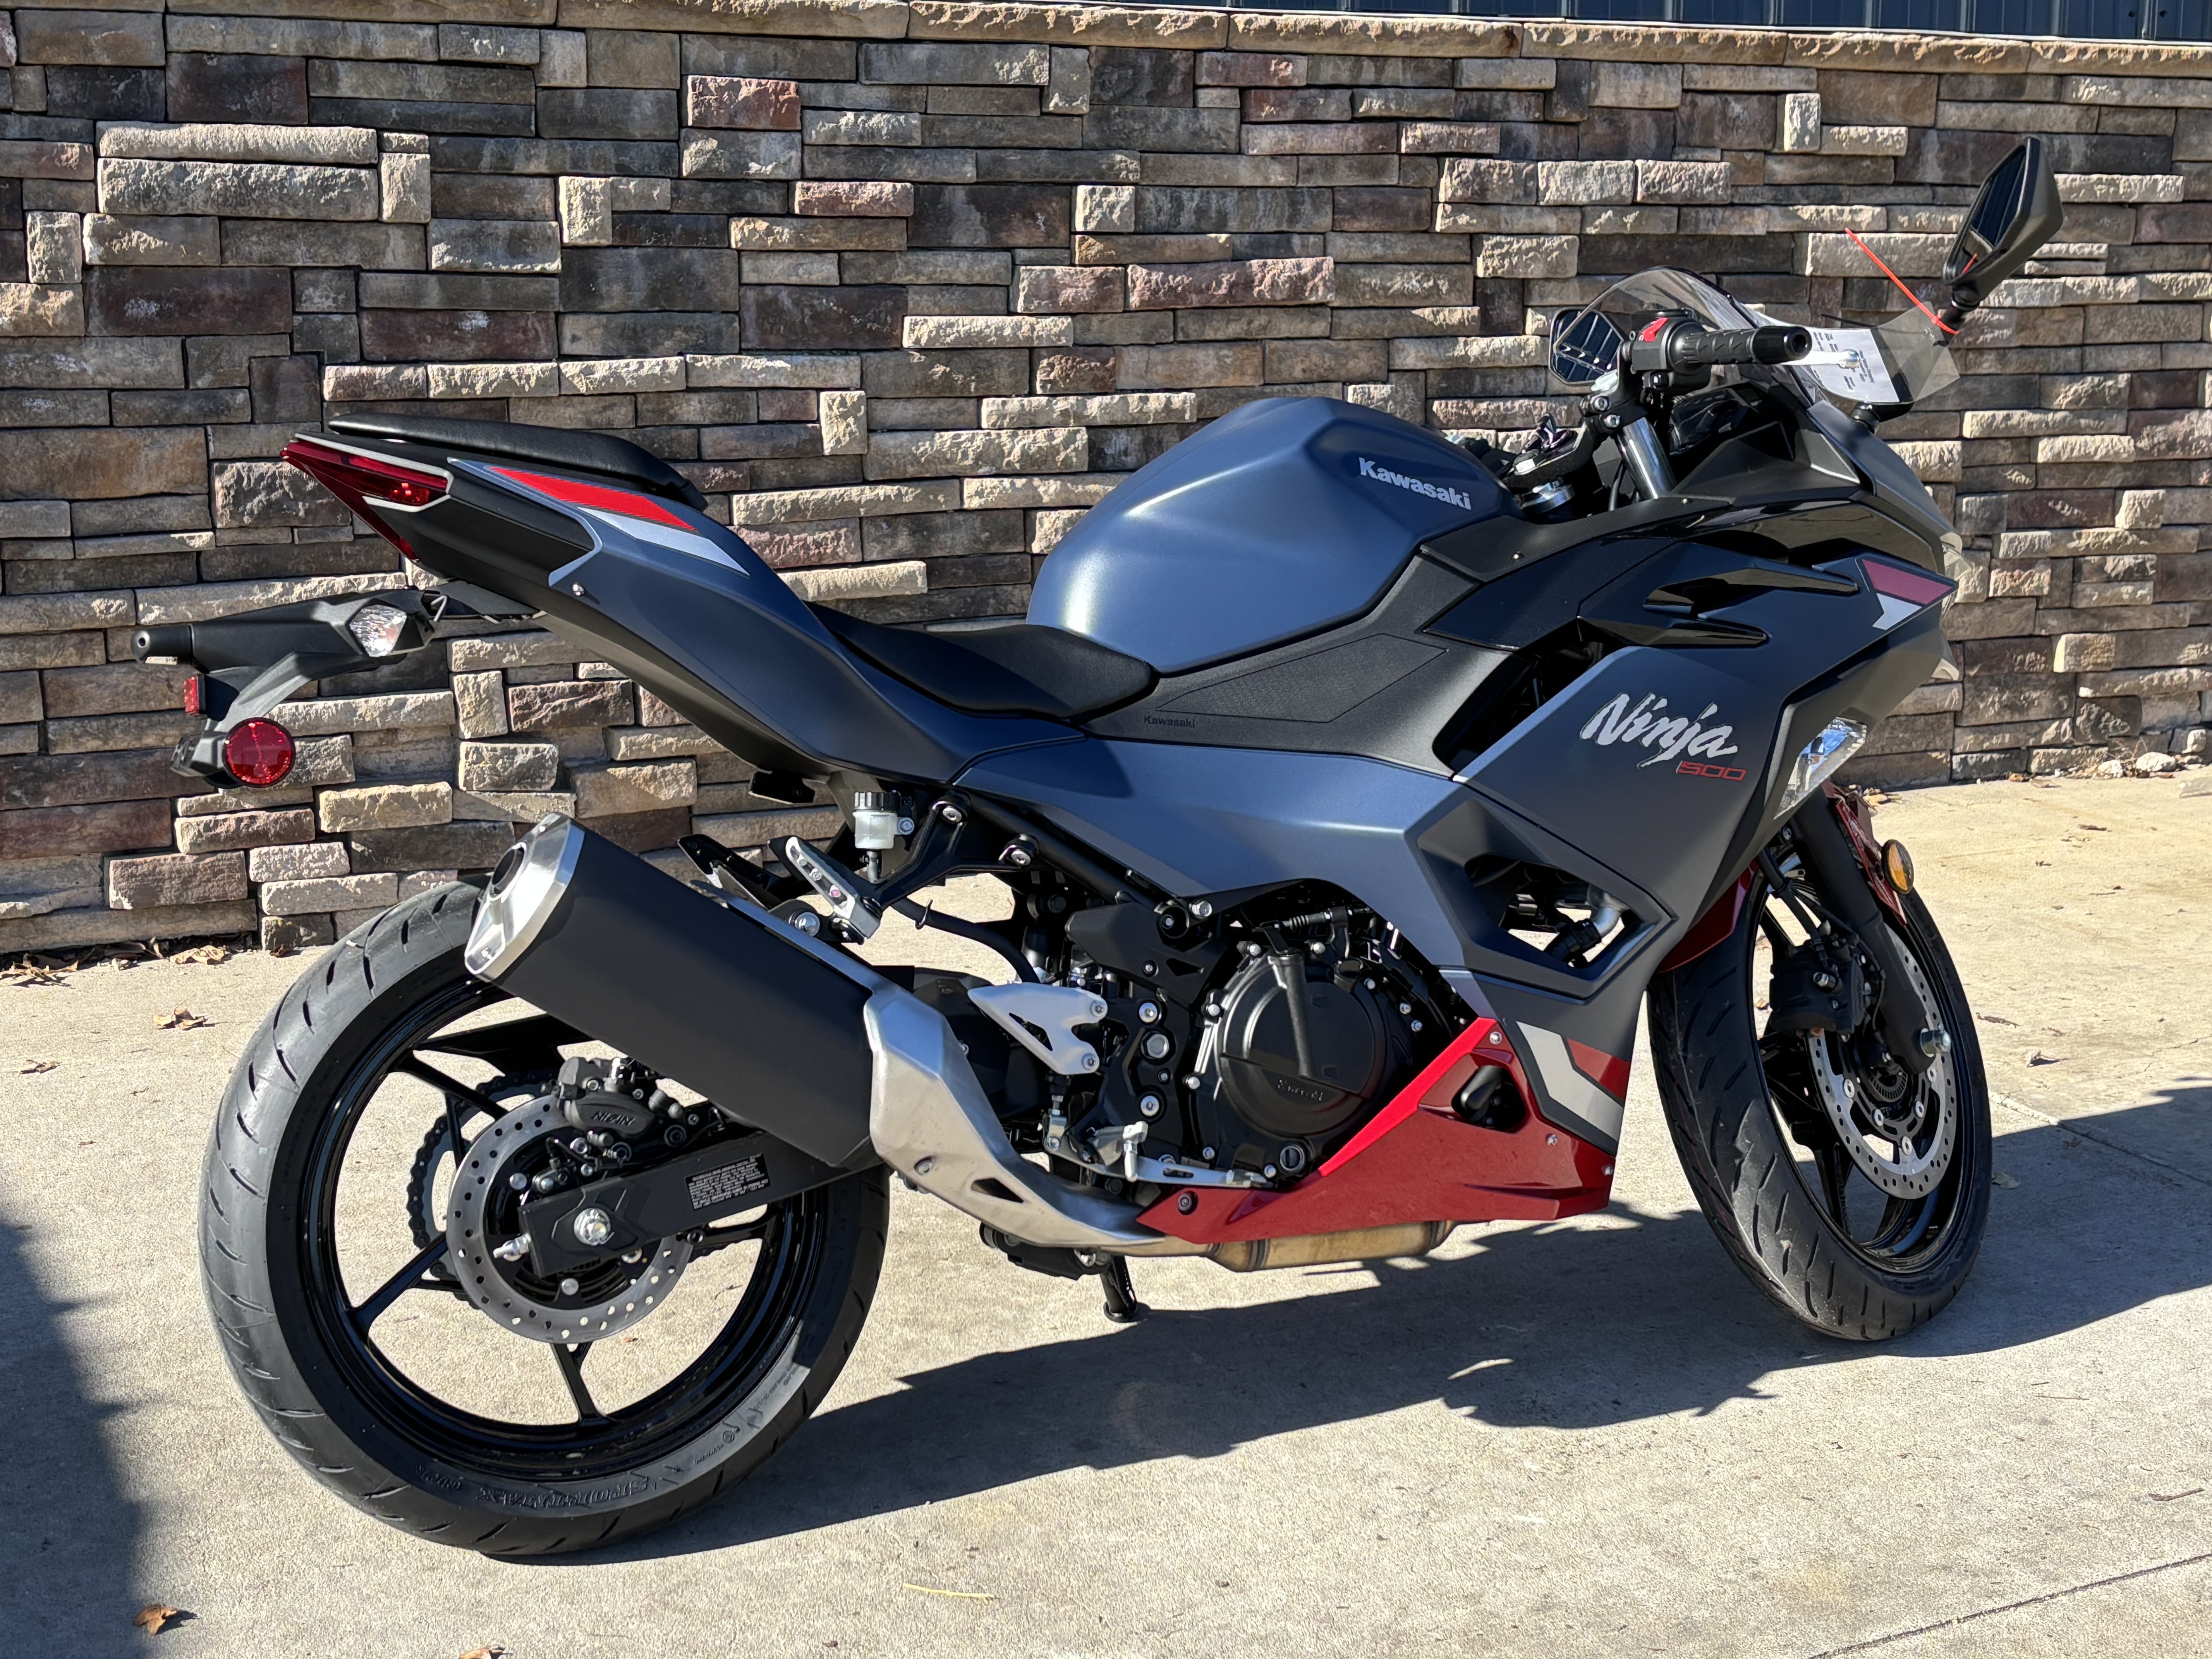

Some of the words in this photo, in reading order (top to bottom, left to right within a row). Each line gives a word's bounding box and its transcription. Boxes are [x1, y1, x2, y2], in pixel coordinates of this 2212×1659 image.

[1359, 457, 1472, 510] Kawasaki
[1144, 715, 1195, 728] Kawasaki
[1580, 692, 1738, 769] Ninja
[1676, 761, 1747, 781] 500
